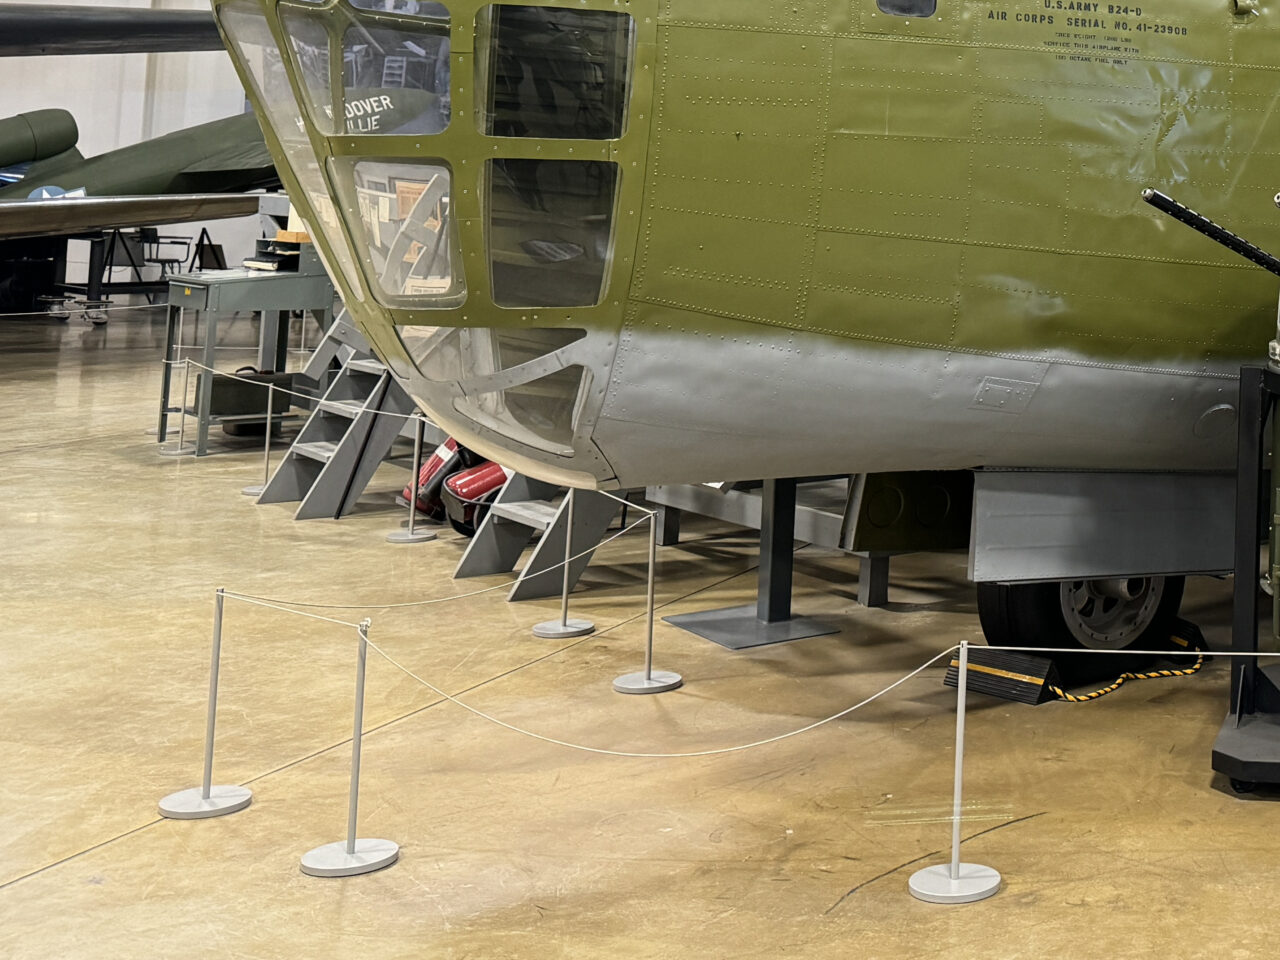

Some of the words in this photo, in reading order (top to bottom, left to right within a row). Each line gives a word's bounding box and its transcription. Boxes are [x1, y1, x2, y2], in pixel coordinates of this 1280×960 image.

[1044, 0, 1099, 13] U.S.ARMY
[1108, 4, 1142, 16] B24-D
[987, 10, 1008, 22] AIR
[1015, 12, 1054, 25] CORPS
[1066, 17, 1107, 29] SERIAL
[1114, 22, 1132, 33] NO.
[1091, 44, 1122, 52] AIRPLANE
[1069, 55, 1092, 63] OCTANE
